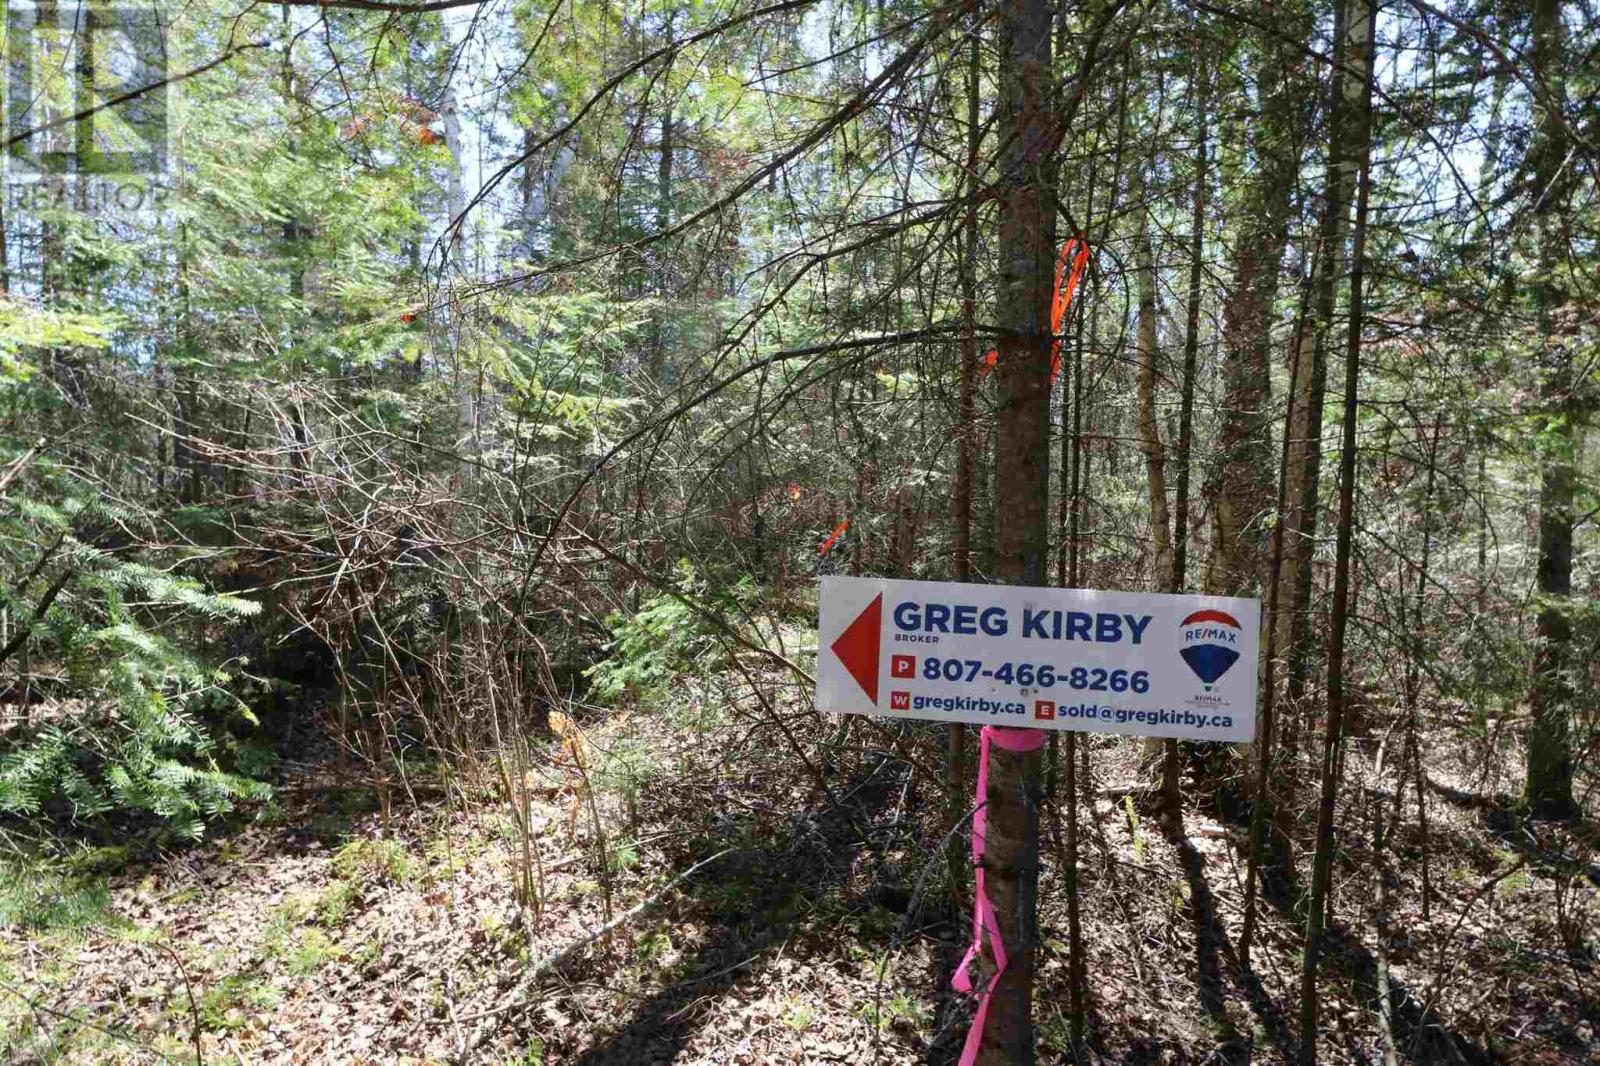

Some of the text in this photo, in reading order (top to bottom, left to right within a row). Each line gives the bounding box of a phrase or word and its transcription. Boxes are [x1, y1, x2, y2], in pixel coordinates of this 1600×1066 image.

[893, 602, 1152, 644] GREG KIRBY
[894, 634, 939, 644] BROKER
[1185, 627, 1237, 644] RE/MAX
[898, 657, 1150, 694] P 807-466-8266
[893, 695, 908, 708] W
[913, 693, 1026, 716] gregkirby.ca
[1041, 705, 1050, 716] E
[1058, 702, 1233, 729] sold@gregkirby.ca
